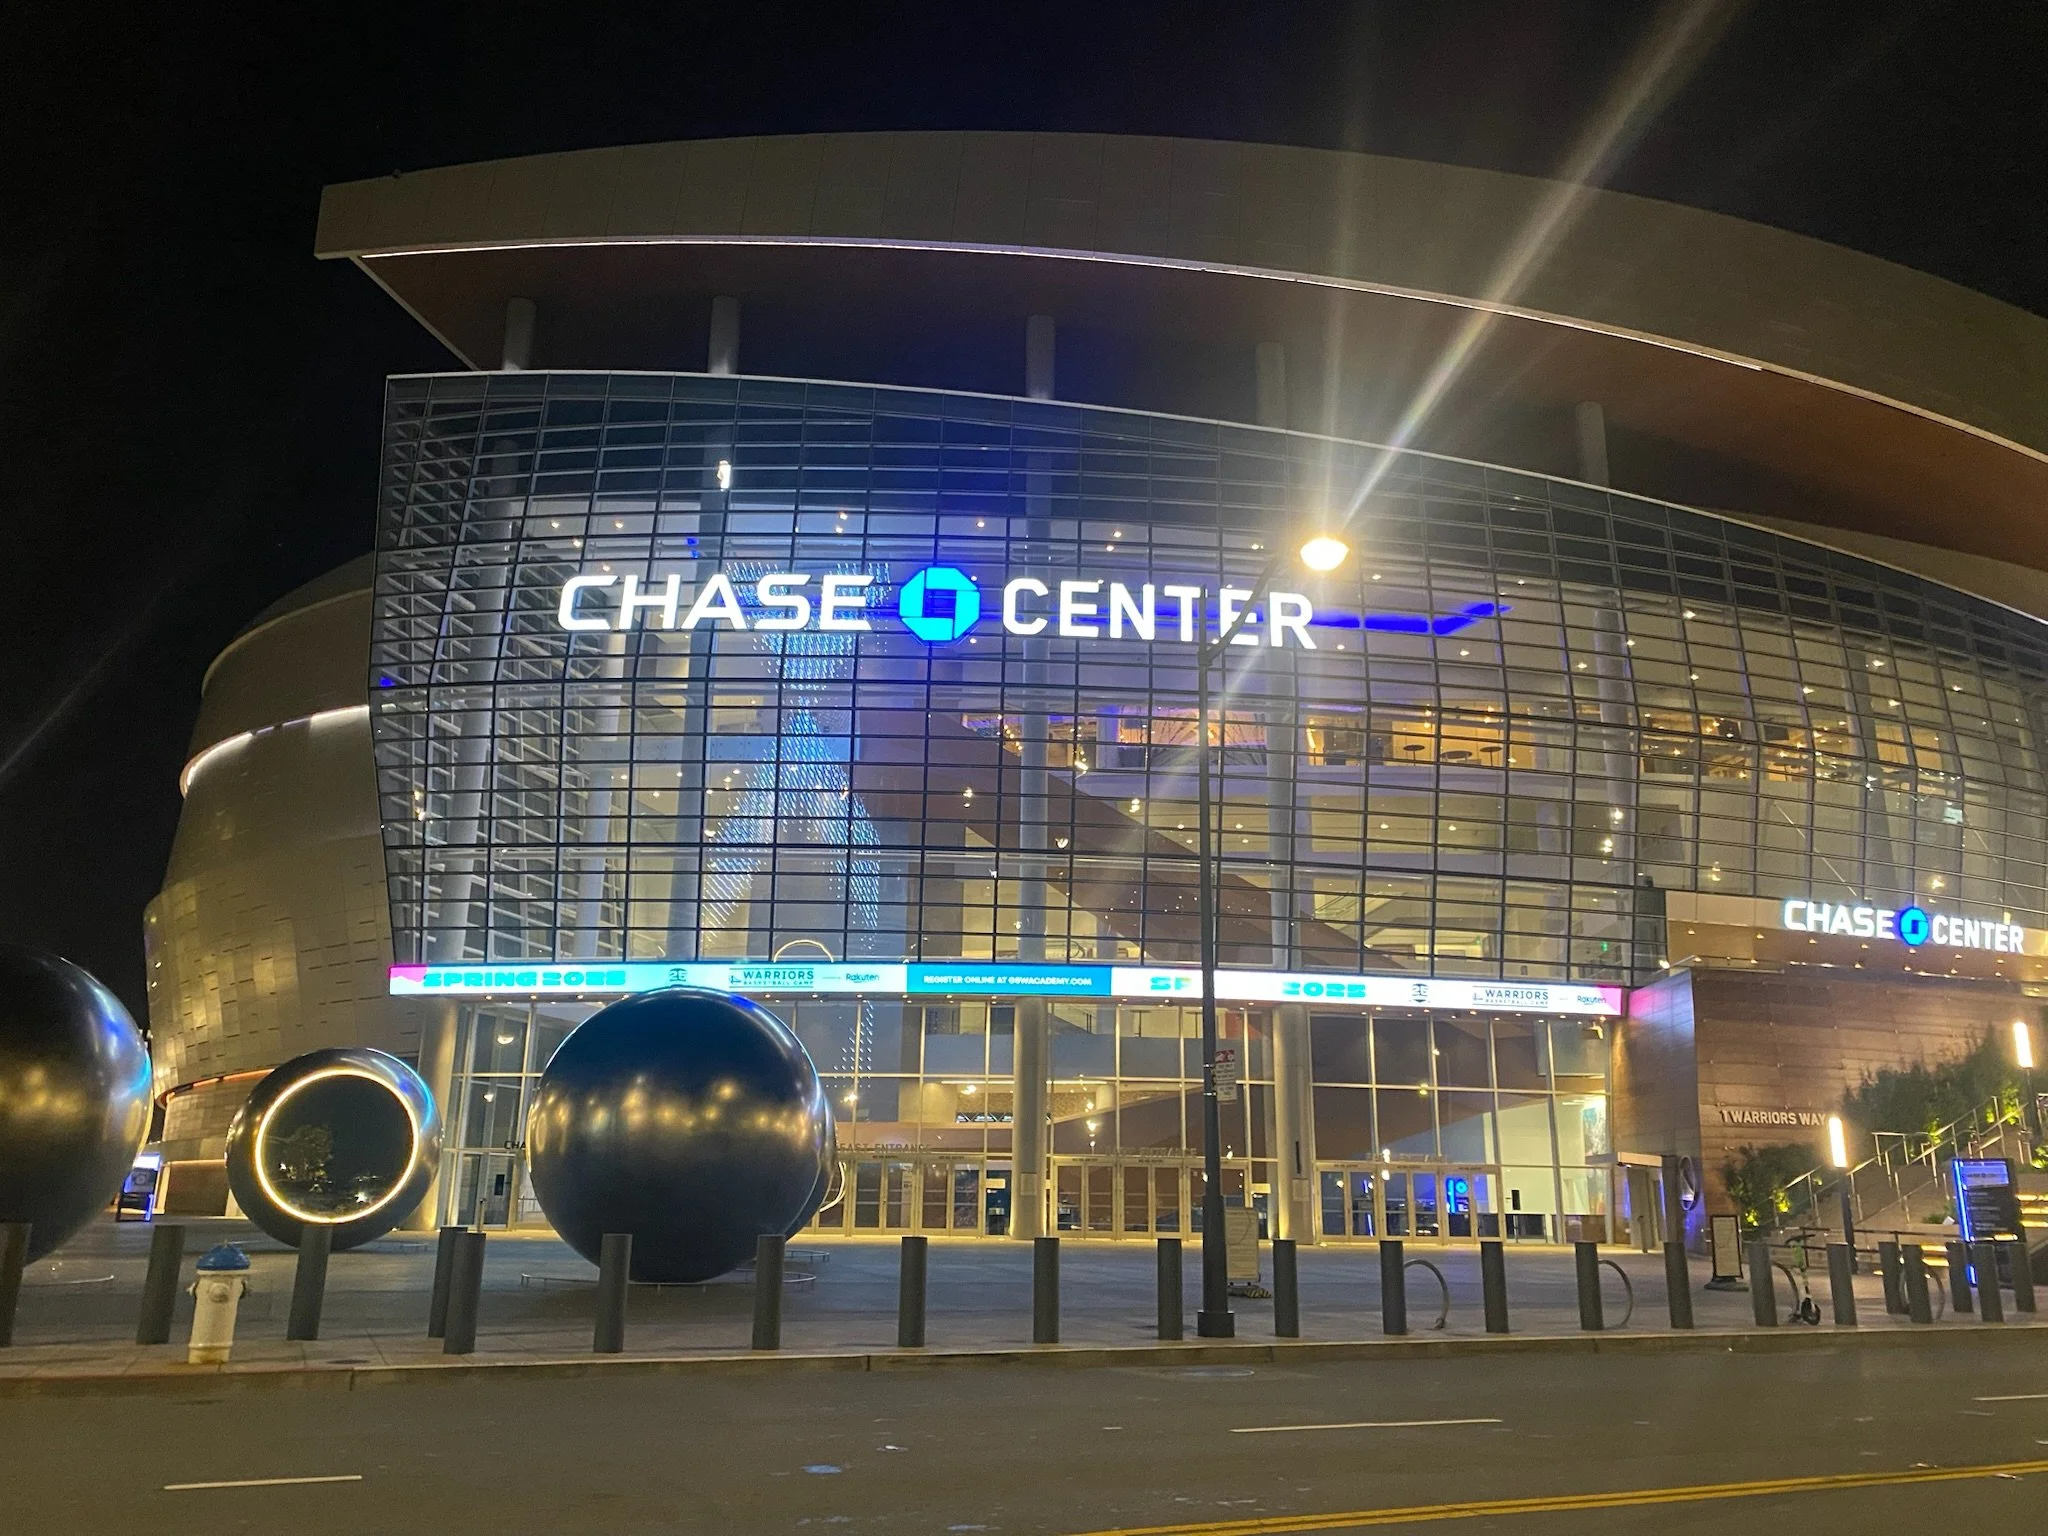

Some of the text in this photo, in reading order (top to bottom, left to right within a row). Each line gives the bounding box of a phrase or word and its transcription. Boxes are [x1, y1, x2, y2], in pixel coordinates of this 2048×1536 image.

[557, 574, 1317, 650] CHASE CENTER
[1783, 900, 2025, 954] CHASE CENTER
[423, 972, 537, 987] SPRING
[743, 970, 814, 980] WARRIORS
[845, 973, 880, 983] Rakuten
[923, 975, 963, 984] REGISTER
[964, 975, 995, 984] ONLINE
[996, 976, 1007, 985] AT
[1485, 989, 1549, 1001] WARRIORS
[1577, 995, 1607, 1005] Rakuten
[1720, 1109, 1827, 1126] 1 WARRIORS WAY
[840, 1143, 869, 1152] EAST
